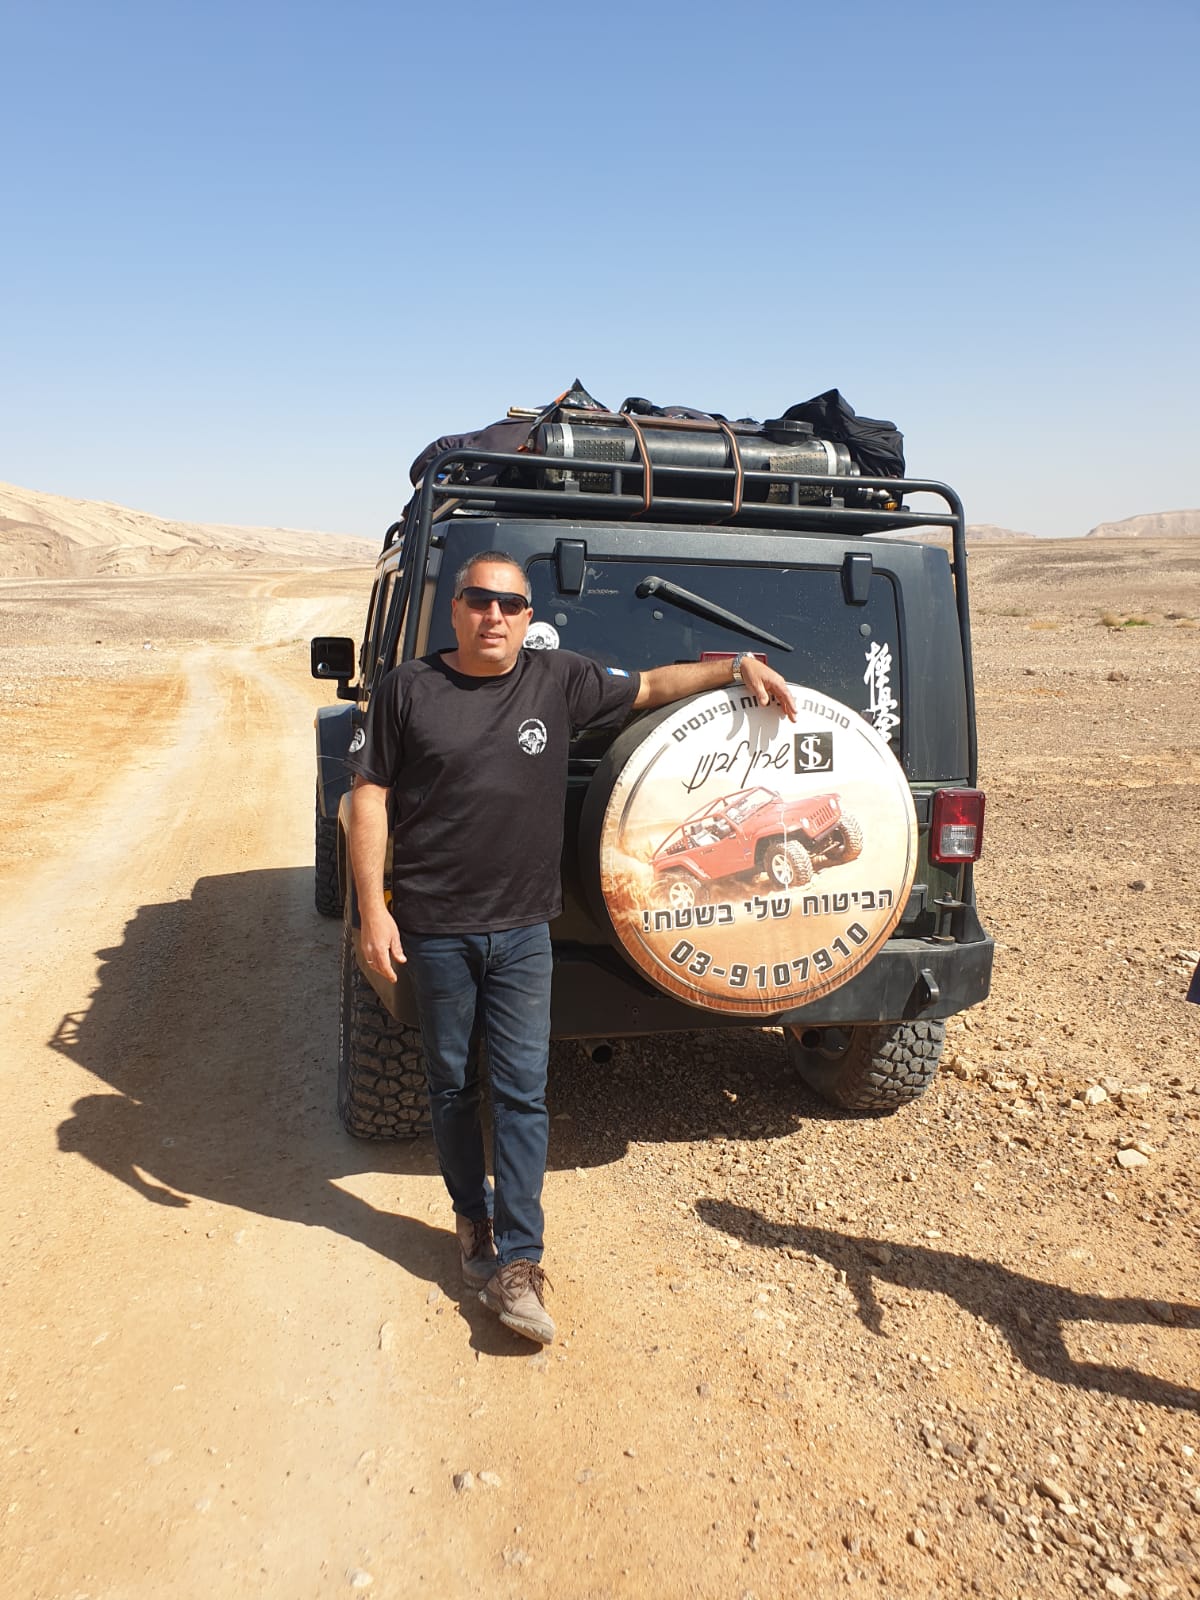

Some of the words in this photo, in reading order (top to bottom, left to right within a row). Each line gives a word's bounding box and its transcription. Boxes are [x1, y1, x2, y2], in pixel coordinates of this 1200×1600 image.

[672, 700, 737, 743] ופיננסים
[801, 699, 850, 730] סוכנות
[741, 743, 791, 789] שרון
[642, 903, 735, 933] בשטח!
[744, 896, 791, 920] שלי
[802, 889, 894, 916] הביטוח
[669, 922, 869, 988] 03-9107910
